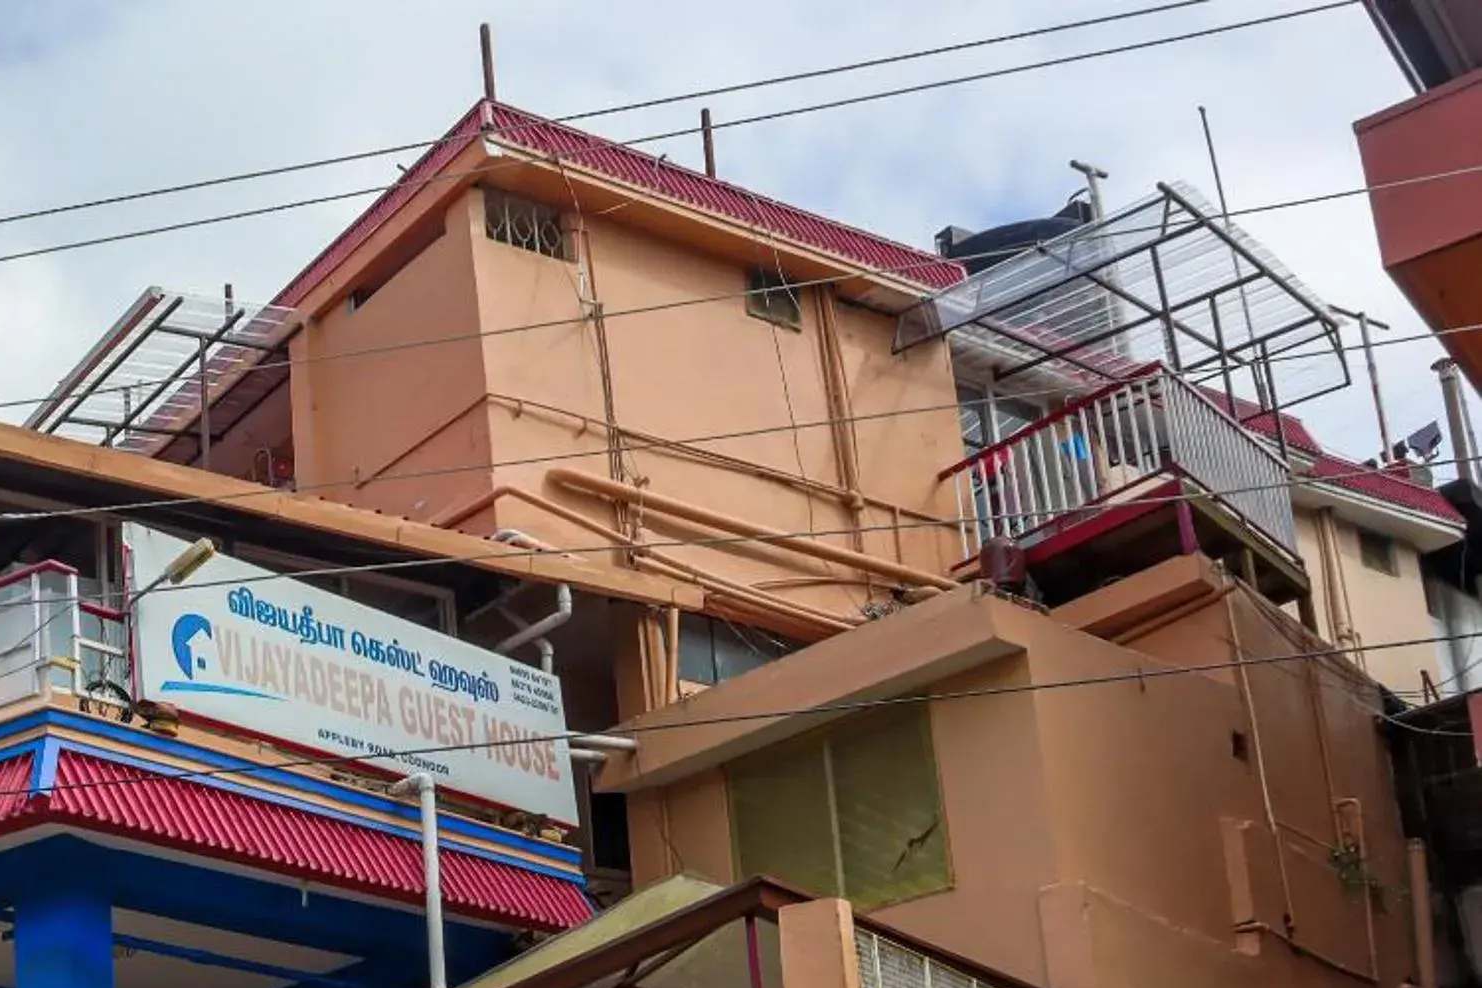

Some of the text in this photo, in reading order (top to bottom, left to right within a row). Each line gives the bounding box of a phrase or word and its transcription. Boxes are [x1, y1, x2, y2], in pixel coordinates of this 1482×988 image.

[227, 586, 347, 651] விஜயதீபா
[350, 630, 426, 677] கெஸ்ட்
[215, 625, 560, 781] VIJAYADEEPA GUEST HOUSE
